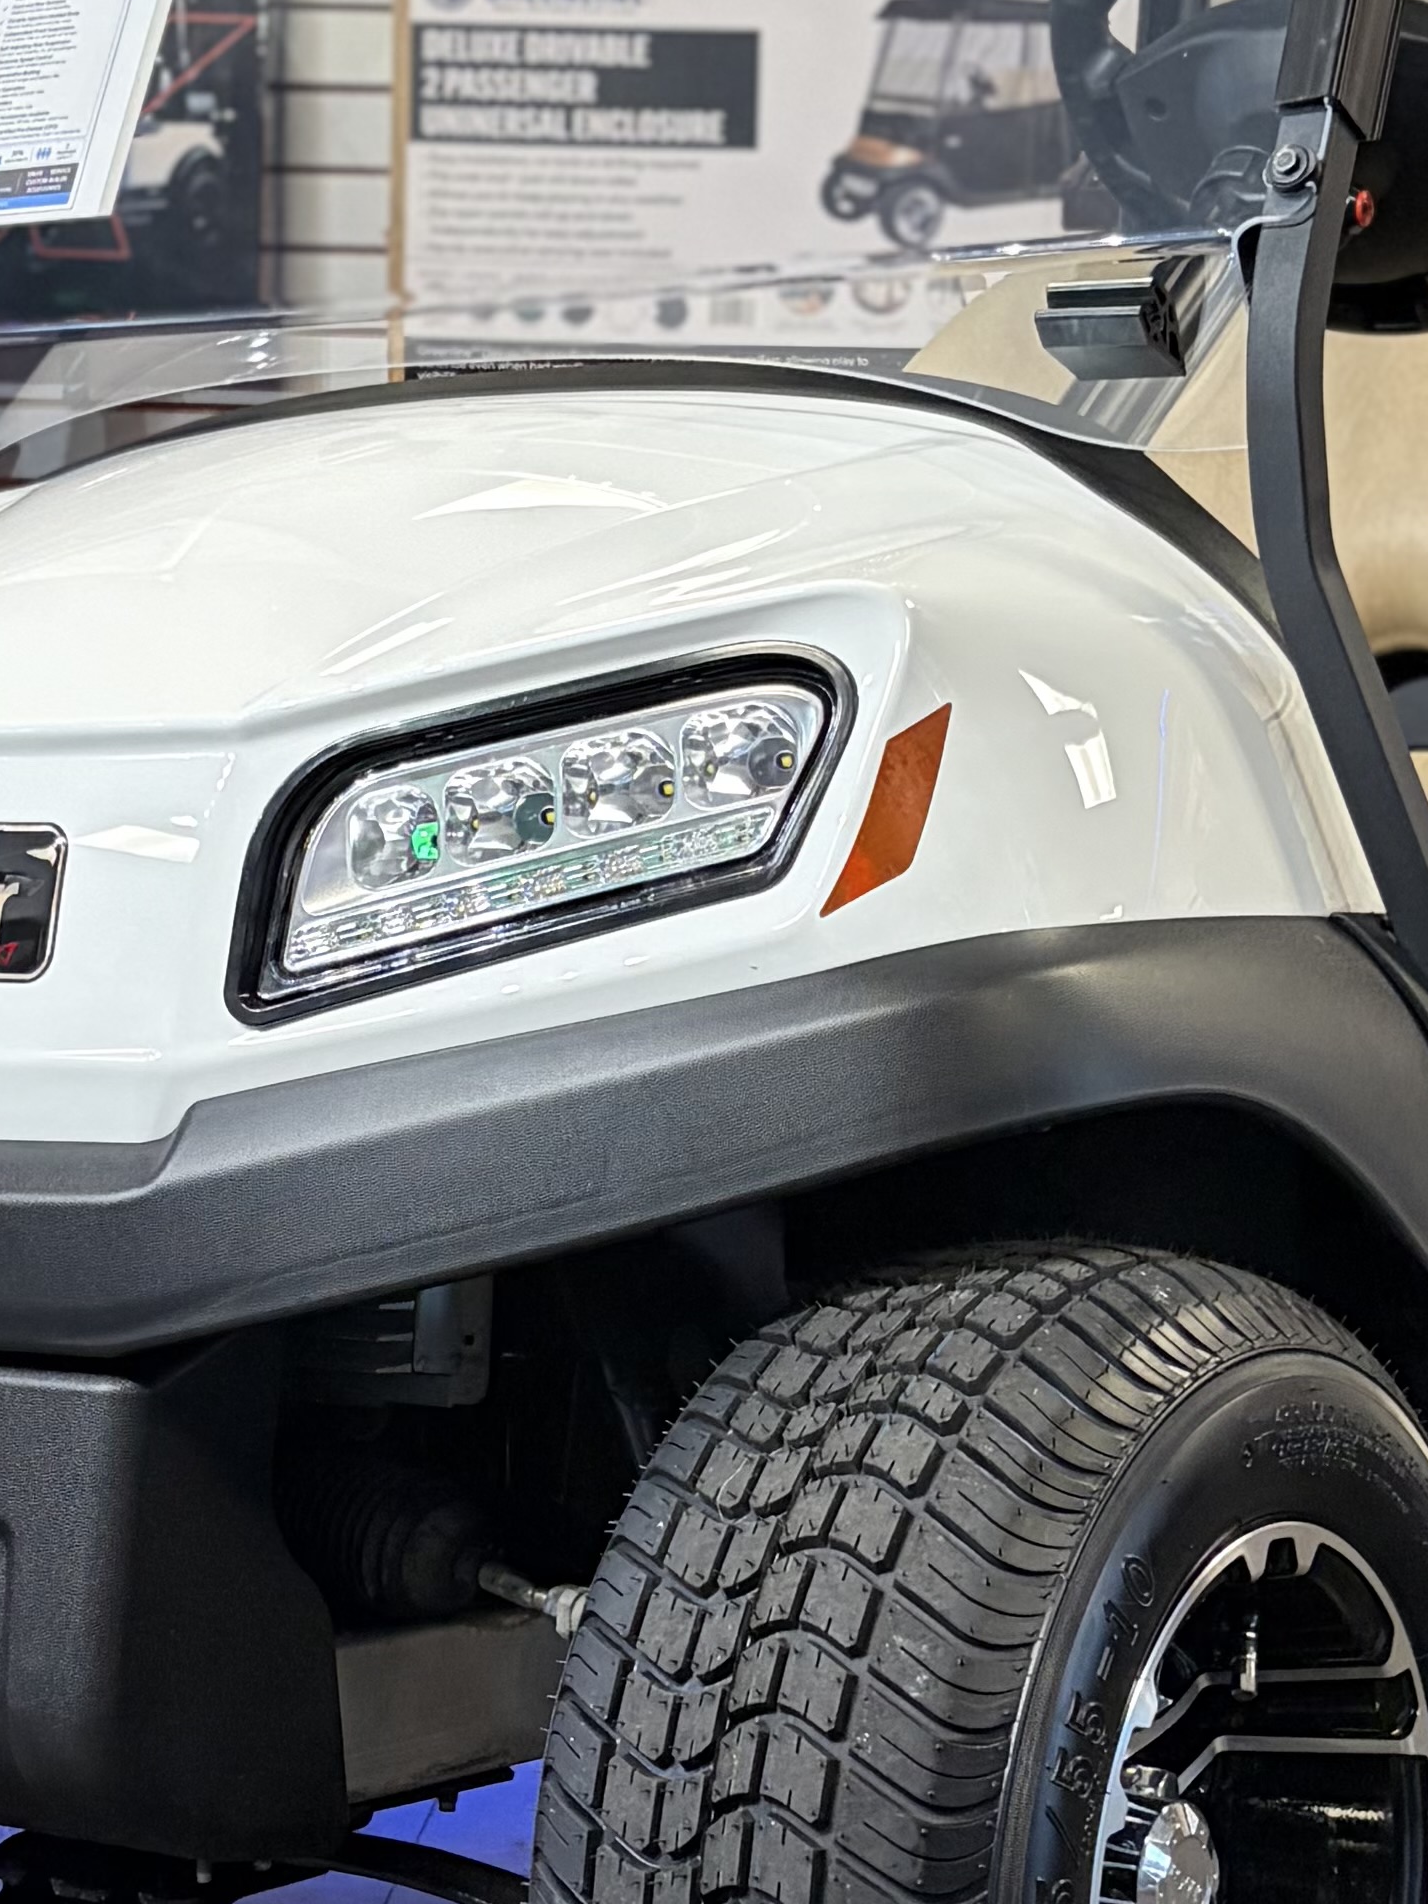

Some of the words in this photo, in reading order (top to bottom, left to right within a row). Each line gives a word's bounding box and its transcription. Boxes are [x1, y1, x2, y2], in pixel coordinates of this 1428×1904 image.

[421, 27, 520, 64] DELUXE
[421, 64, 441, 100] 2
[442, 67, 599, 105] PASSENGER
[573, 107, 728, 145] ENCLOSURE
